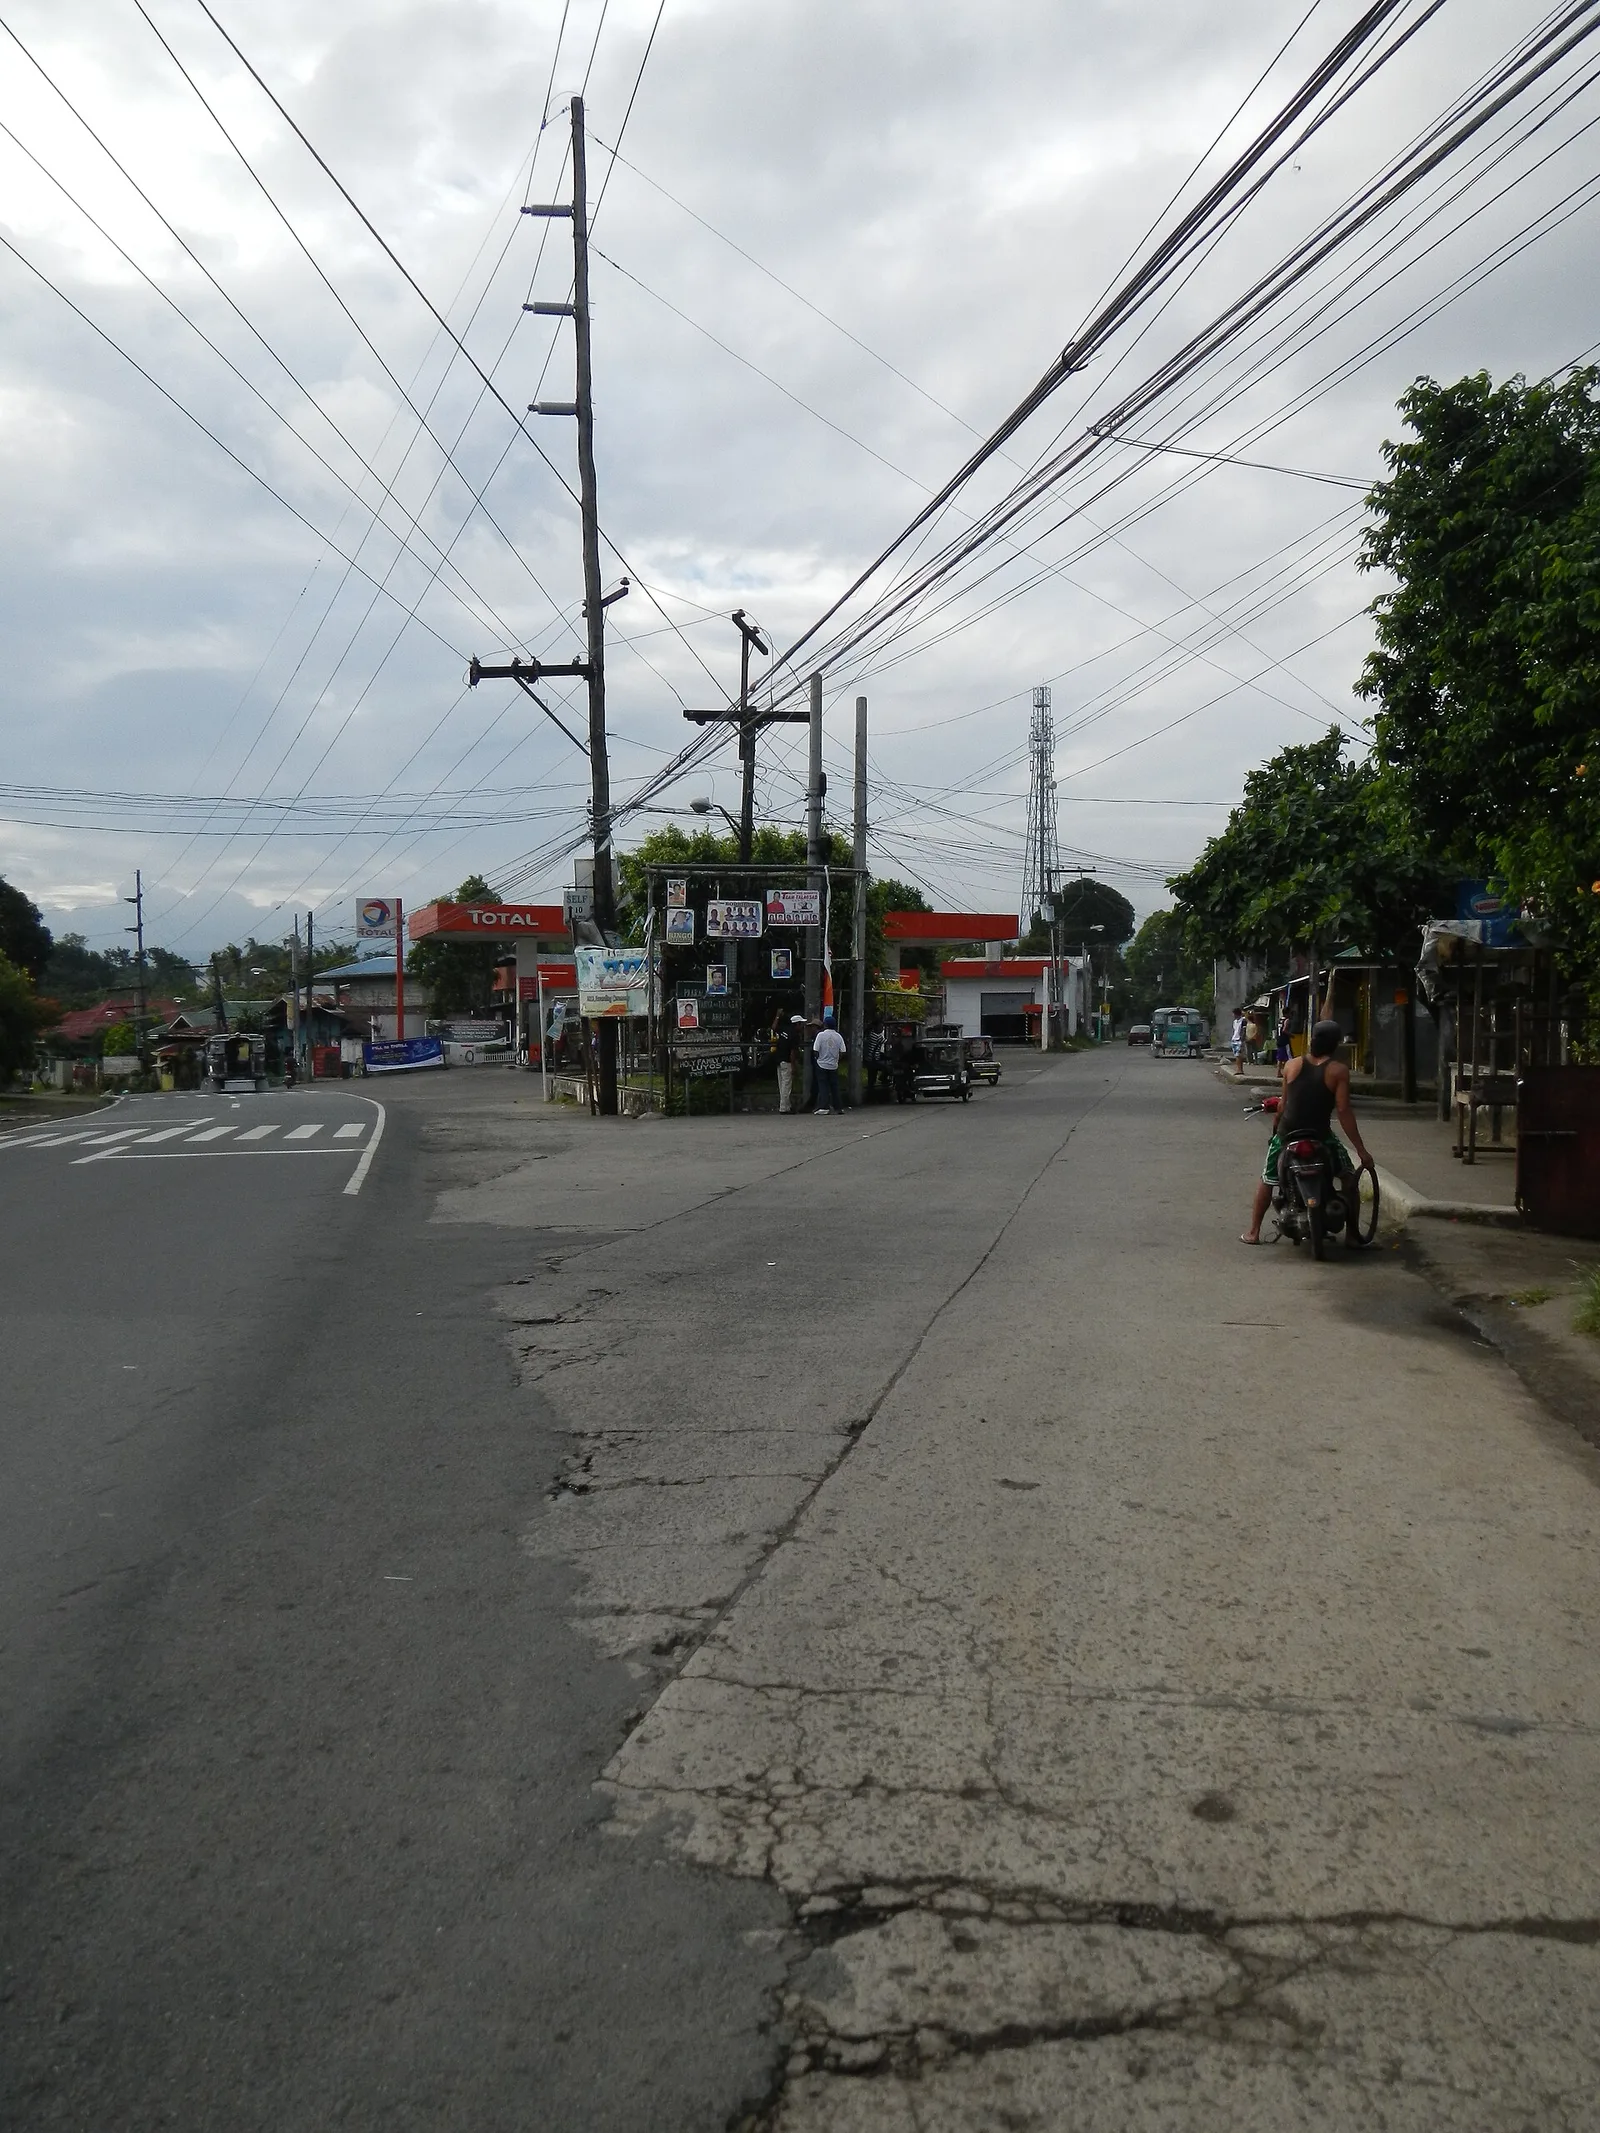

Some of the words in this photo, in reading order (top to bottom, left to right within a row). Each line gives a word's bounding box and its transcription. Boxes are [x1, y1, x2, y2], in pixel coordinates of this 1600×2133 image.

[567, 895, 588, 903] SELF
[575, 906, 583, 914] 10
[467, 910, 539, 926] TOTAL
[359, 927, 396, 937] TOTAL
[679, 1060, 697, 1068] HOLY
[696, 1057, 720, 1066] FAMILY
[721, 1054, 744, 1063] PARISH
[691, 1063, 722, 1072] LUYOS
